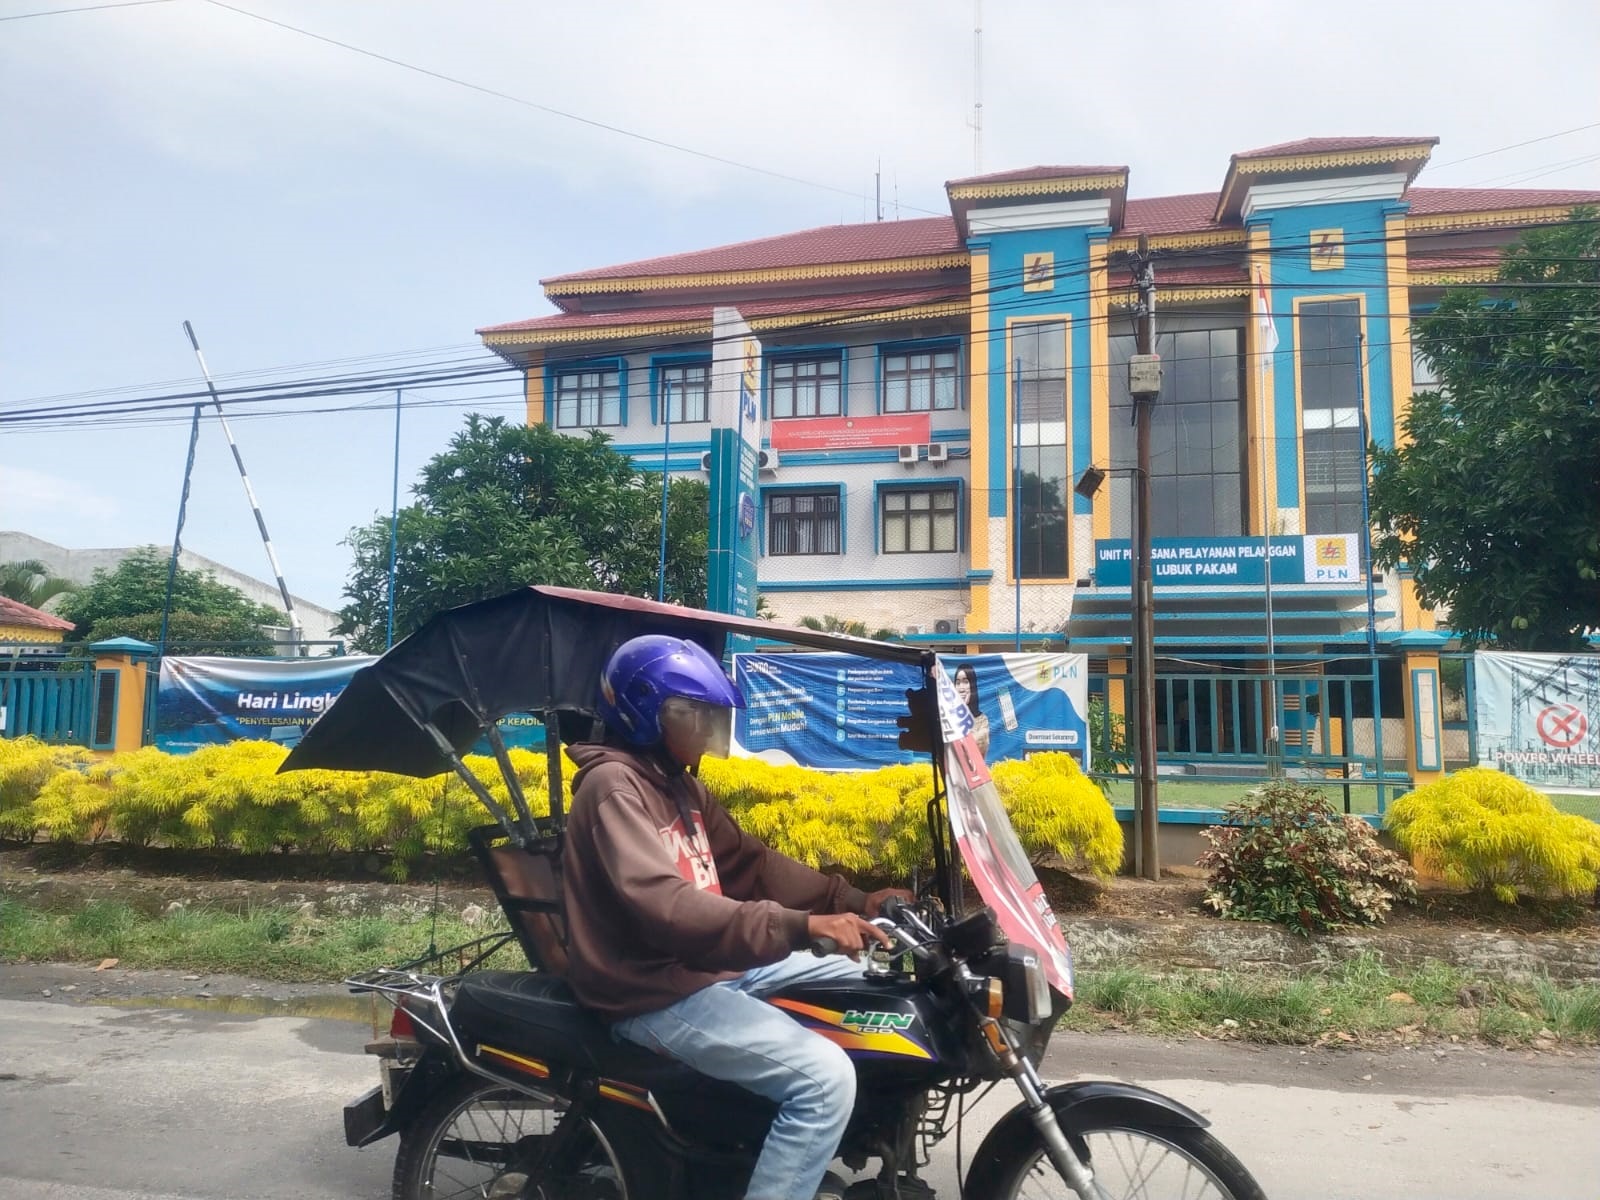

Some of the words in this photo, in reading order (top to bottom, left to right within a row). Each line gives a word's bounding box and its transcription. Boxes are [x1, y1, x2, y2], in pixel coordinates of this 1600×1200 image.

[1099, 548, 1121, 561] UNIT
[1179, 546, 1236, 559] PELAYANAN
[1238, 544, 1296, 558] PELANGGAN
[1156, 563, 1192, 576] LUBUK
[1195, 562, 1238, 575] PAKAM
[1316, 569, 1348, 579] PLN
[1053, 665, 1078, 679] PLN
[237, 692, 278, 709] Hari
[767, 712, 781, 722] PLN
[1495, 751, 1549, 764] POWER
[841, 1010, 916, 1029] WIN
